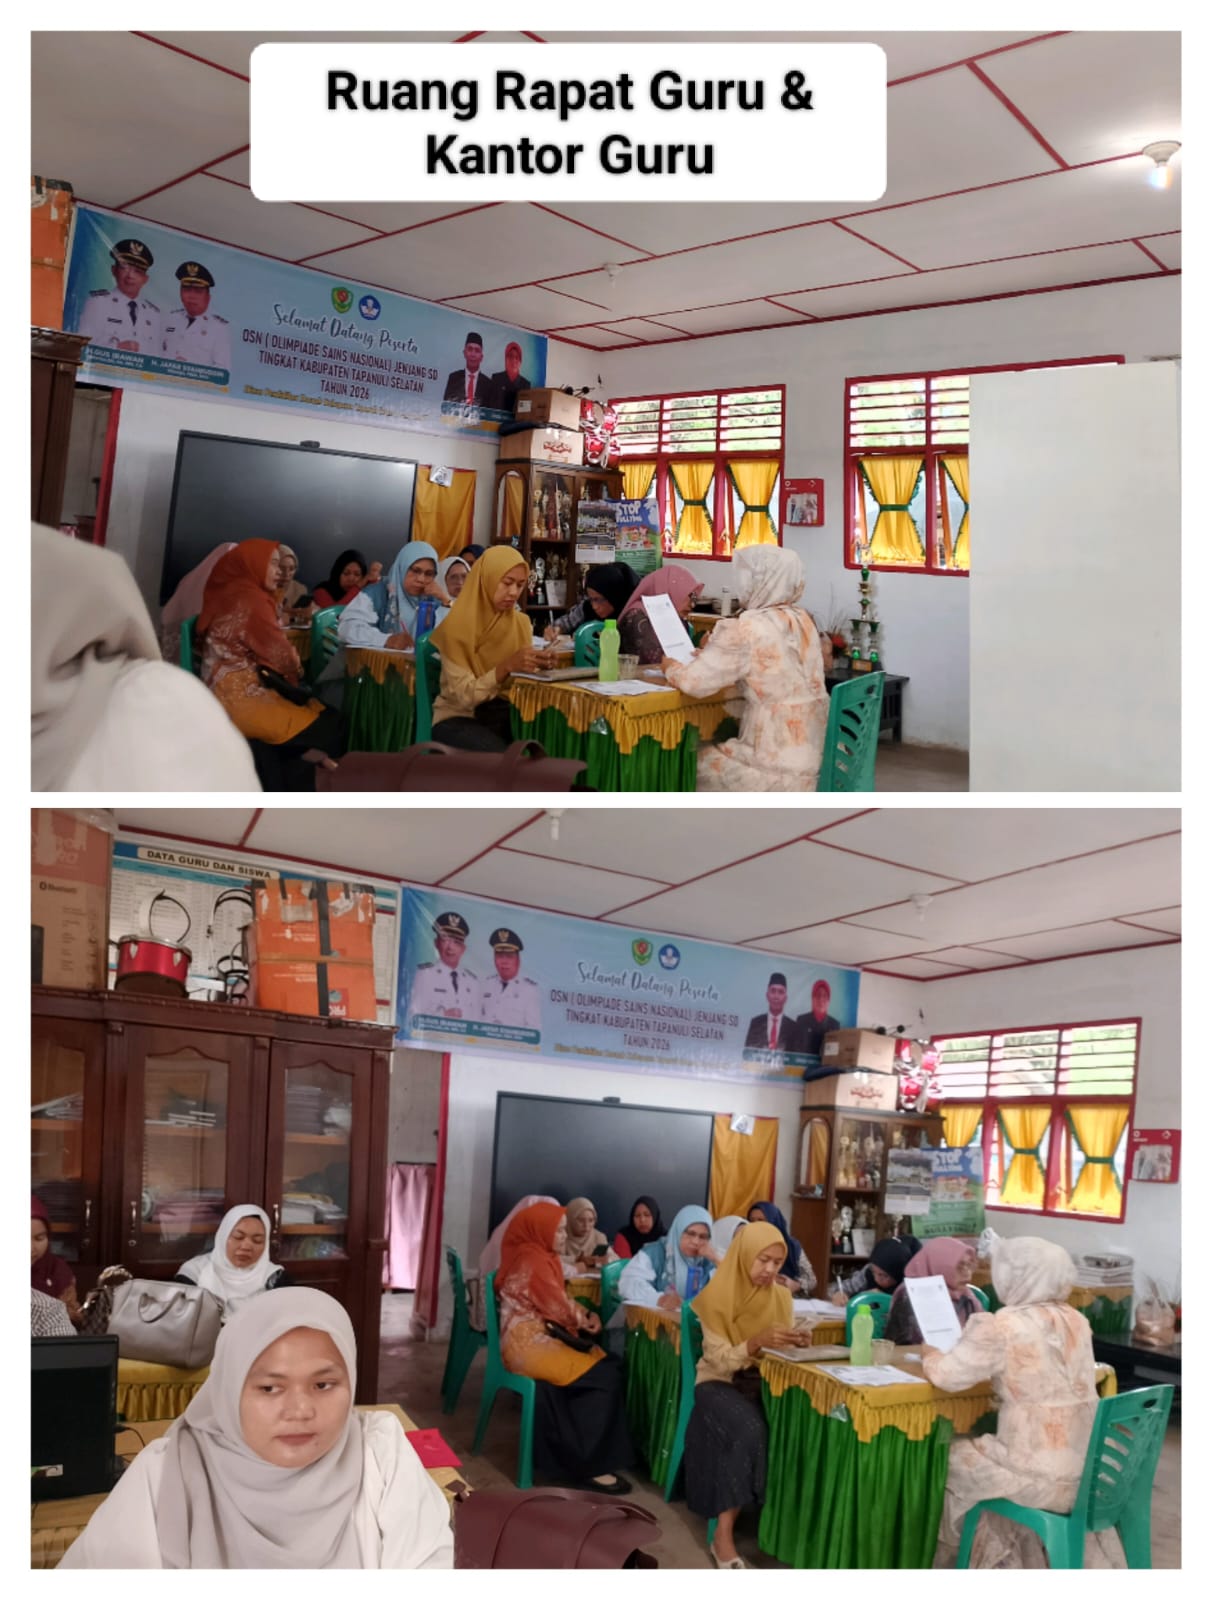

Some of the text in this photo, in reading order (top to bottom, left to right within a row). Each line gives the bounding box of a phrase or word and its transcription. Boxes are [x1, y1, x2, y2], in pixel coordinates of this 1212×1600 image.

[272, 303, 418, 353] Selamat Datang Peserta
[242, 328, 263, 345] OSN
[271, 334, 320, 357] OLIMPIADE
[321, 345, 348, 362] SAINS
[393, 360, 426, 379] JENJANG
[427, 368, 438, 381] SD
[259, 350, 425, 393] TINGKAT KABUPATEN TAPANULI SELATAN
[320, 379, 369, 400] TAHUN 2026
[616, 500, 641, 516] STOP
[147, 850, 271, 879] DATA GURU DAN SISWA
[577, 961, 719, 1001] Selamat Datang Peserta
[551, 989, 568, 1003] OSN
[577, 992, 621, 1012] OLIMPIADE
[623, 1000, 649, 1015] SAINS
[566, 1008, 725, 1041] TINGKAT KABUPATEN TAPANULI SELATAN
[623, 1033, 649, 1049] TAHUN
